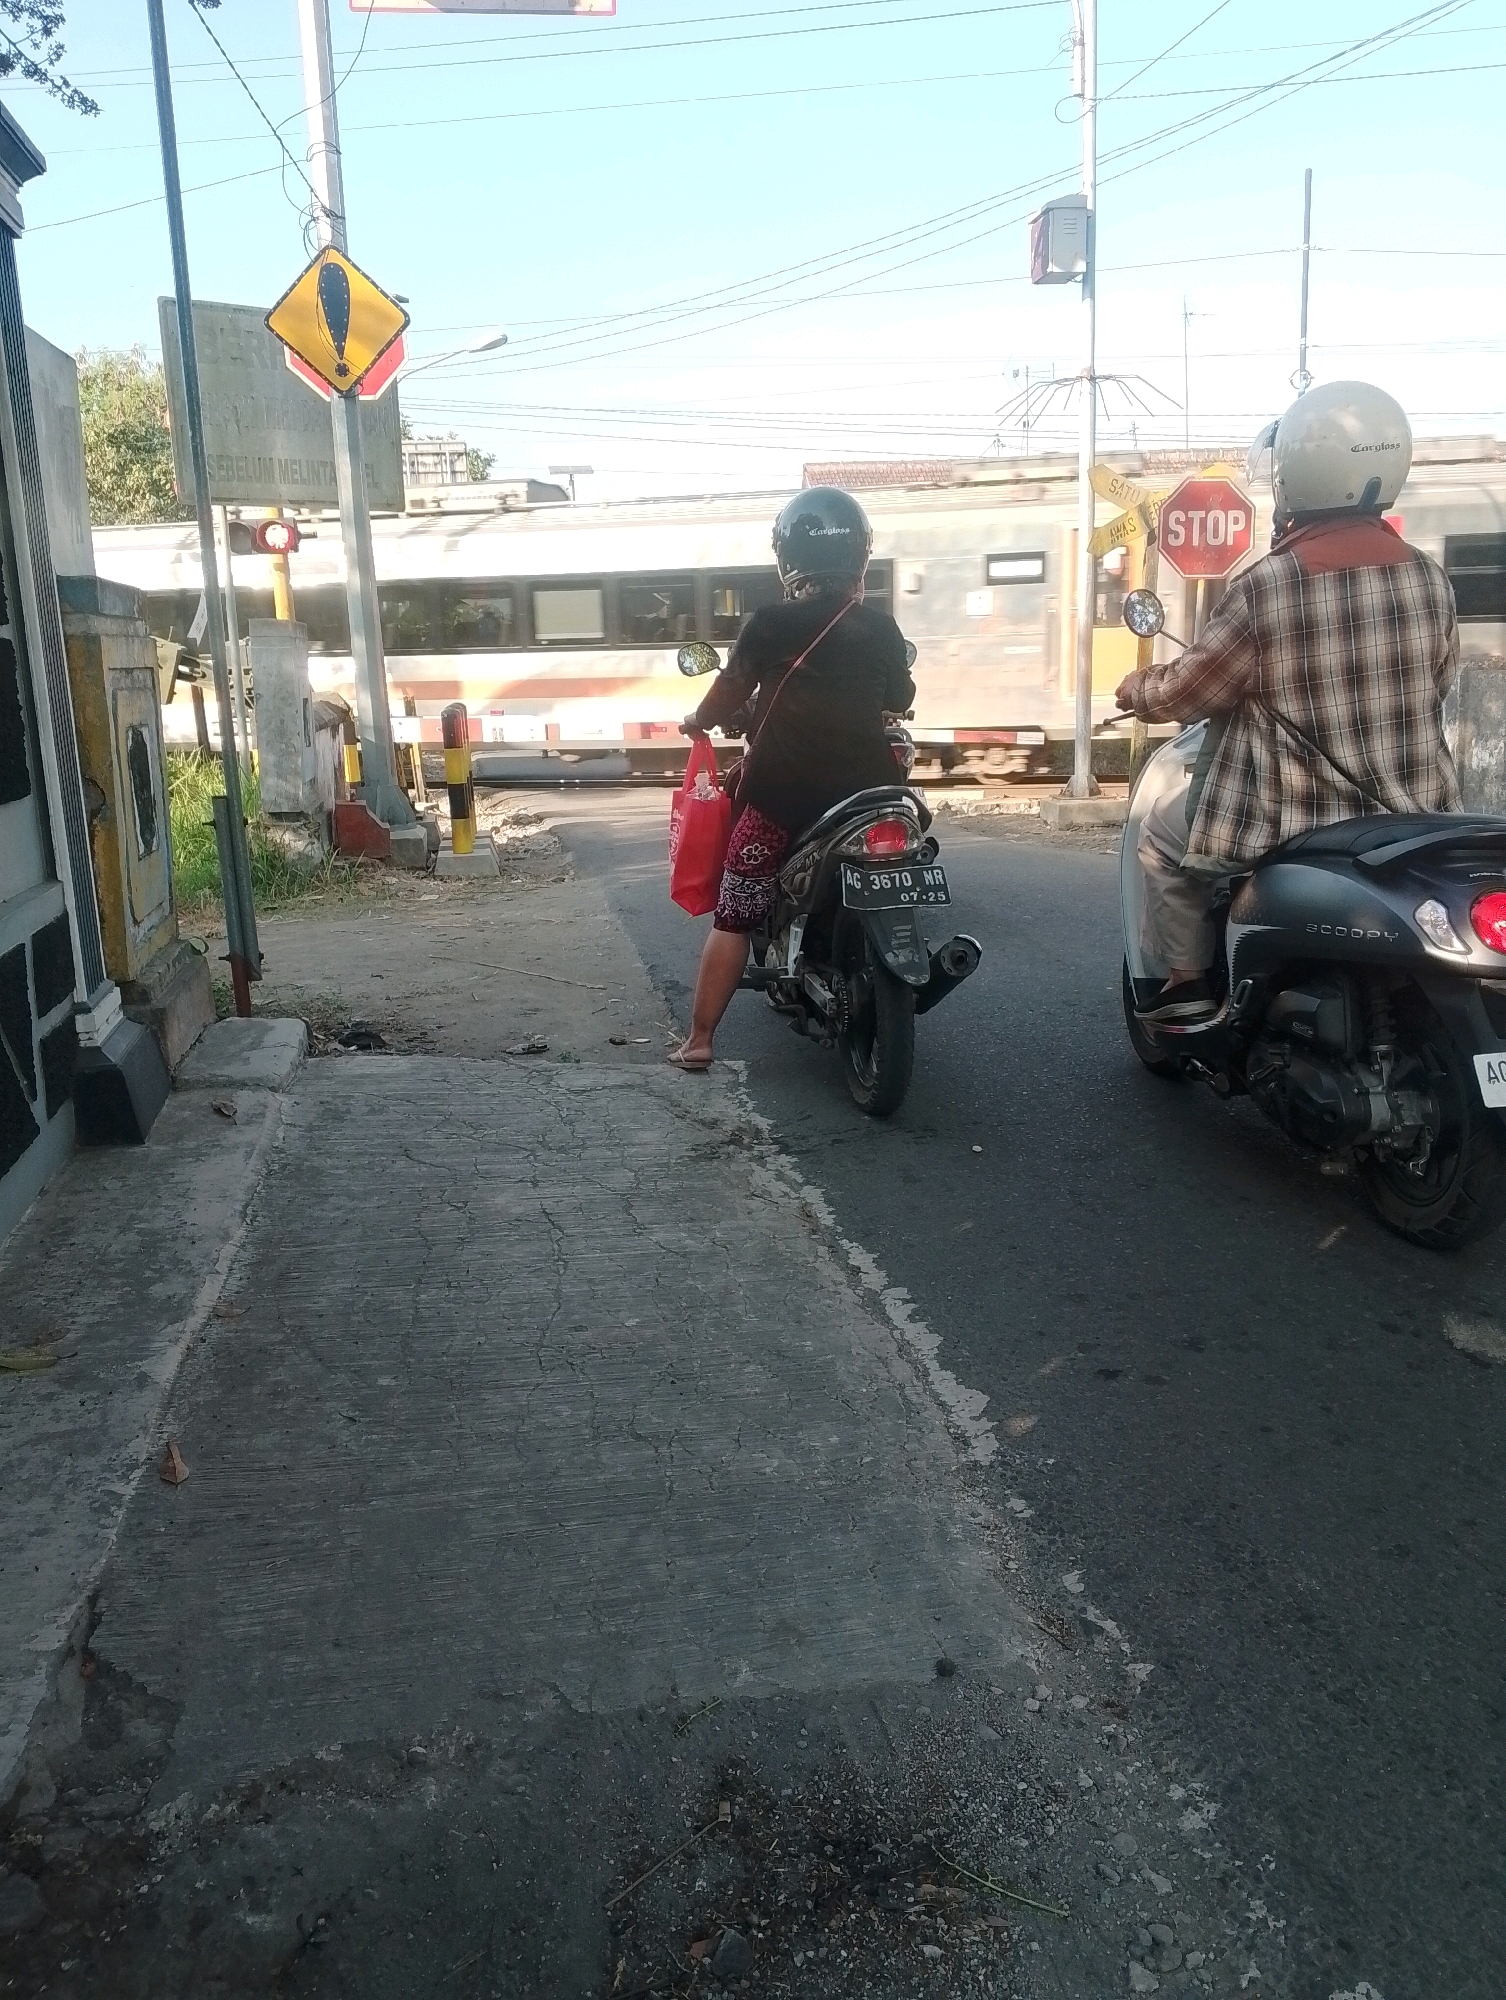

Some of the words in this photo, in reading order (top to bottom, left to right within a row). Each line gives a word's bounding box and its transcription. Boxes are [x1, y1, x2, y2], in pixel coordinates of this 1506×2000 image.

[1350, 442, 1401, 453] Cargloss
[207, 453, 275, 483] SEBELUM
[277, 457, 338, 487] MELINTA
[1108, 478, 1141, 504] SATU
[1109, 517, 1137, 545] AWAS
[1167, 510, 1246, 547] STOP
[846, 869, 862, 889] AG
[869, 872, 913, 890] 3670
[922, 869, 945, 886] NR
[1305, 923, 1399, 942] SCOOPY
